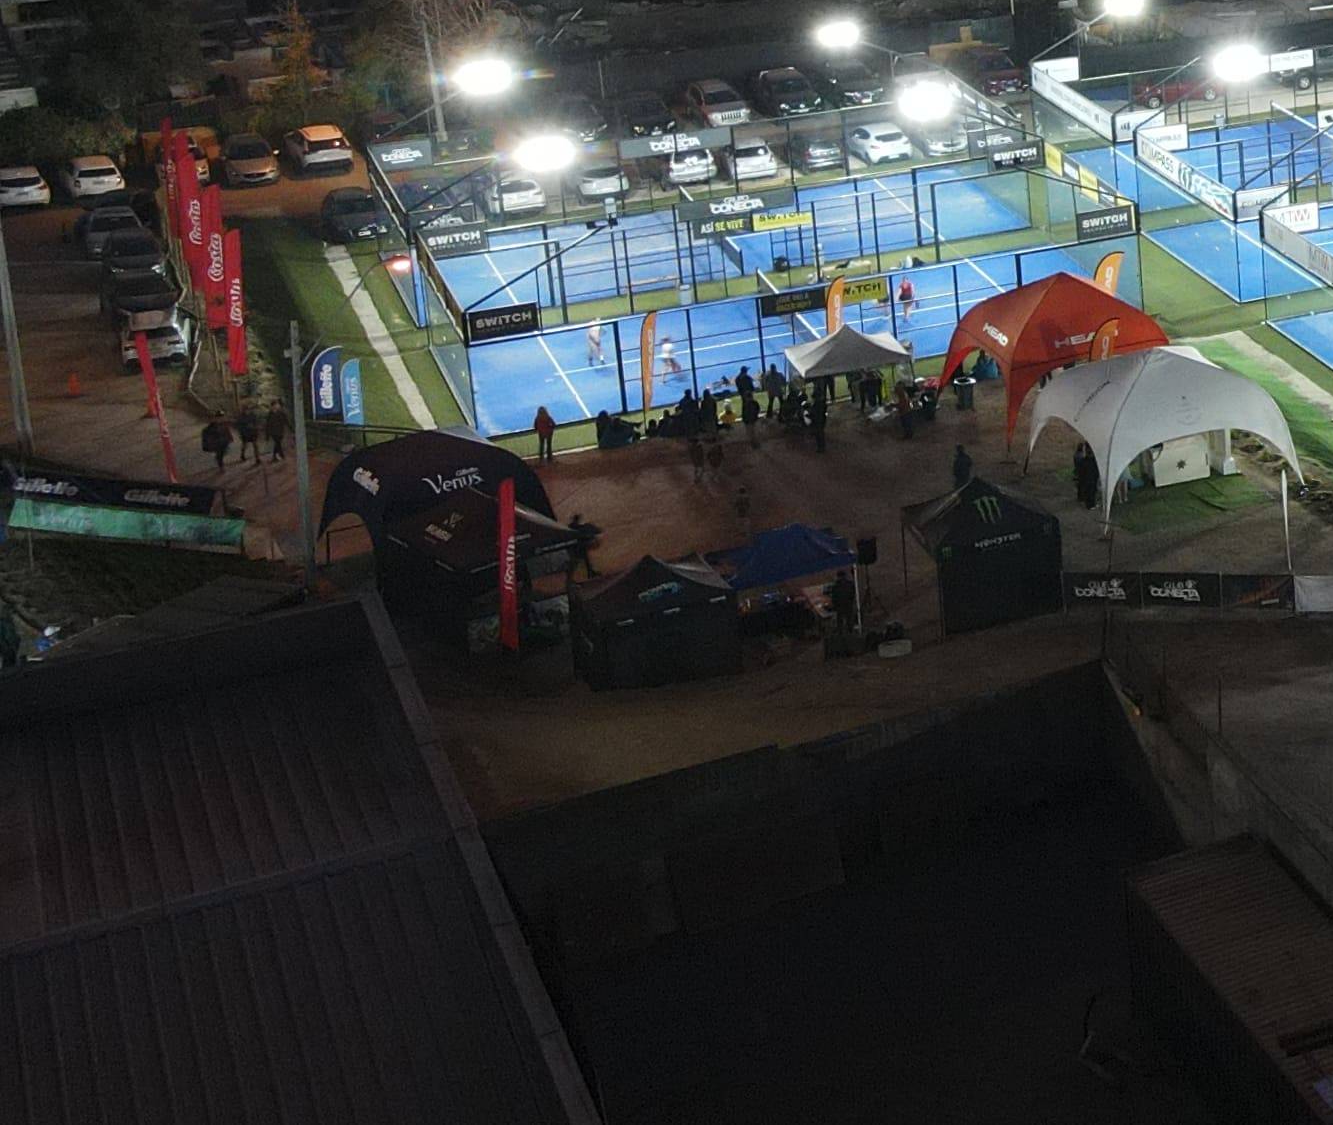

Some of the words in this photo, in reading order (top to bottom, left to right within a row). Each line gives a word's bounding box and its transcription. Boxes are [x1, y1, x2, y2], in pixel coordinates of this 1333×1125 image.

[993, 147, 1037, 161] SWITCH
[1081, 211, 1129, 229] SWITCH
[427, 230, 481, 247] SWITCH
[475, 310, 532, 329] SWITCH
[982, 322, 1009, 347] HEAD
[422, 473, 485, 496] Venus
